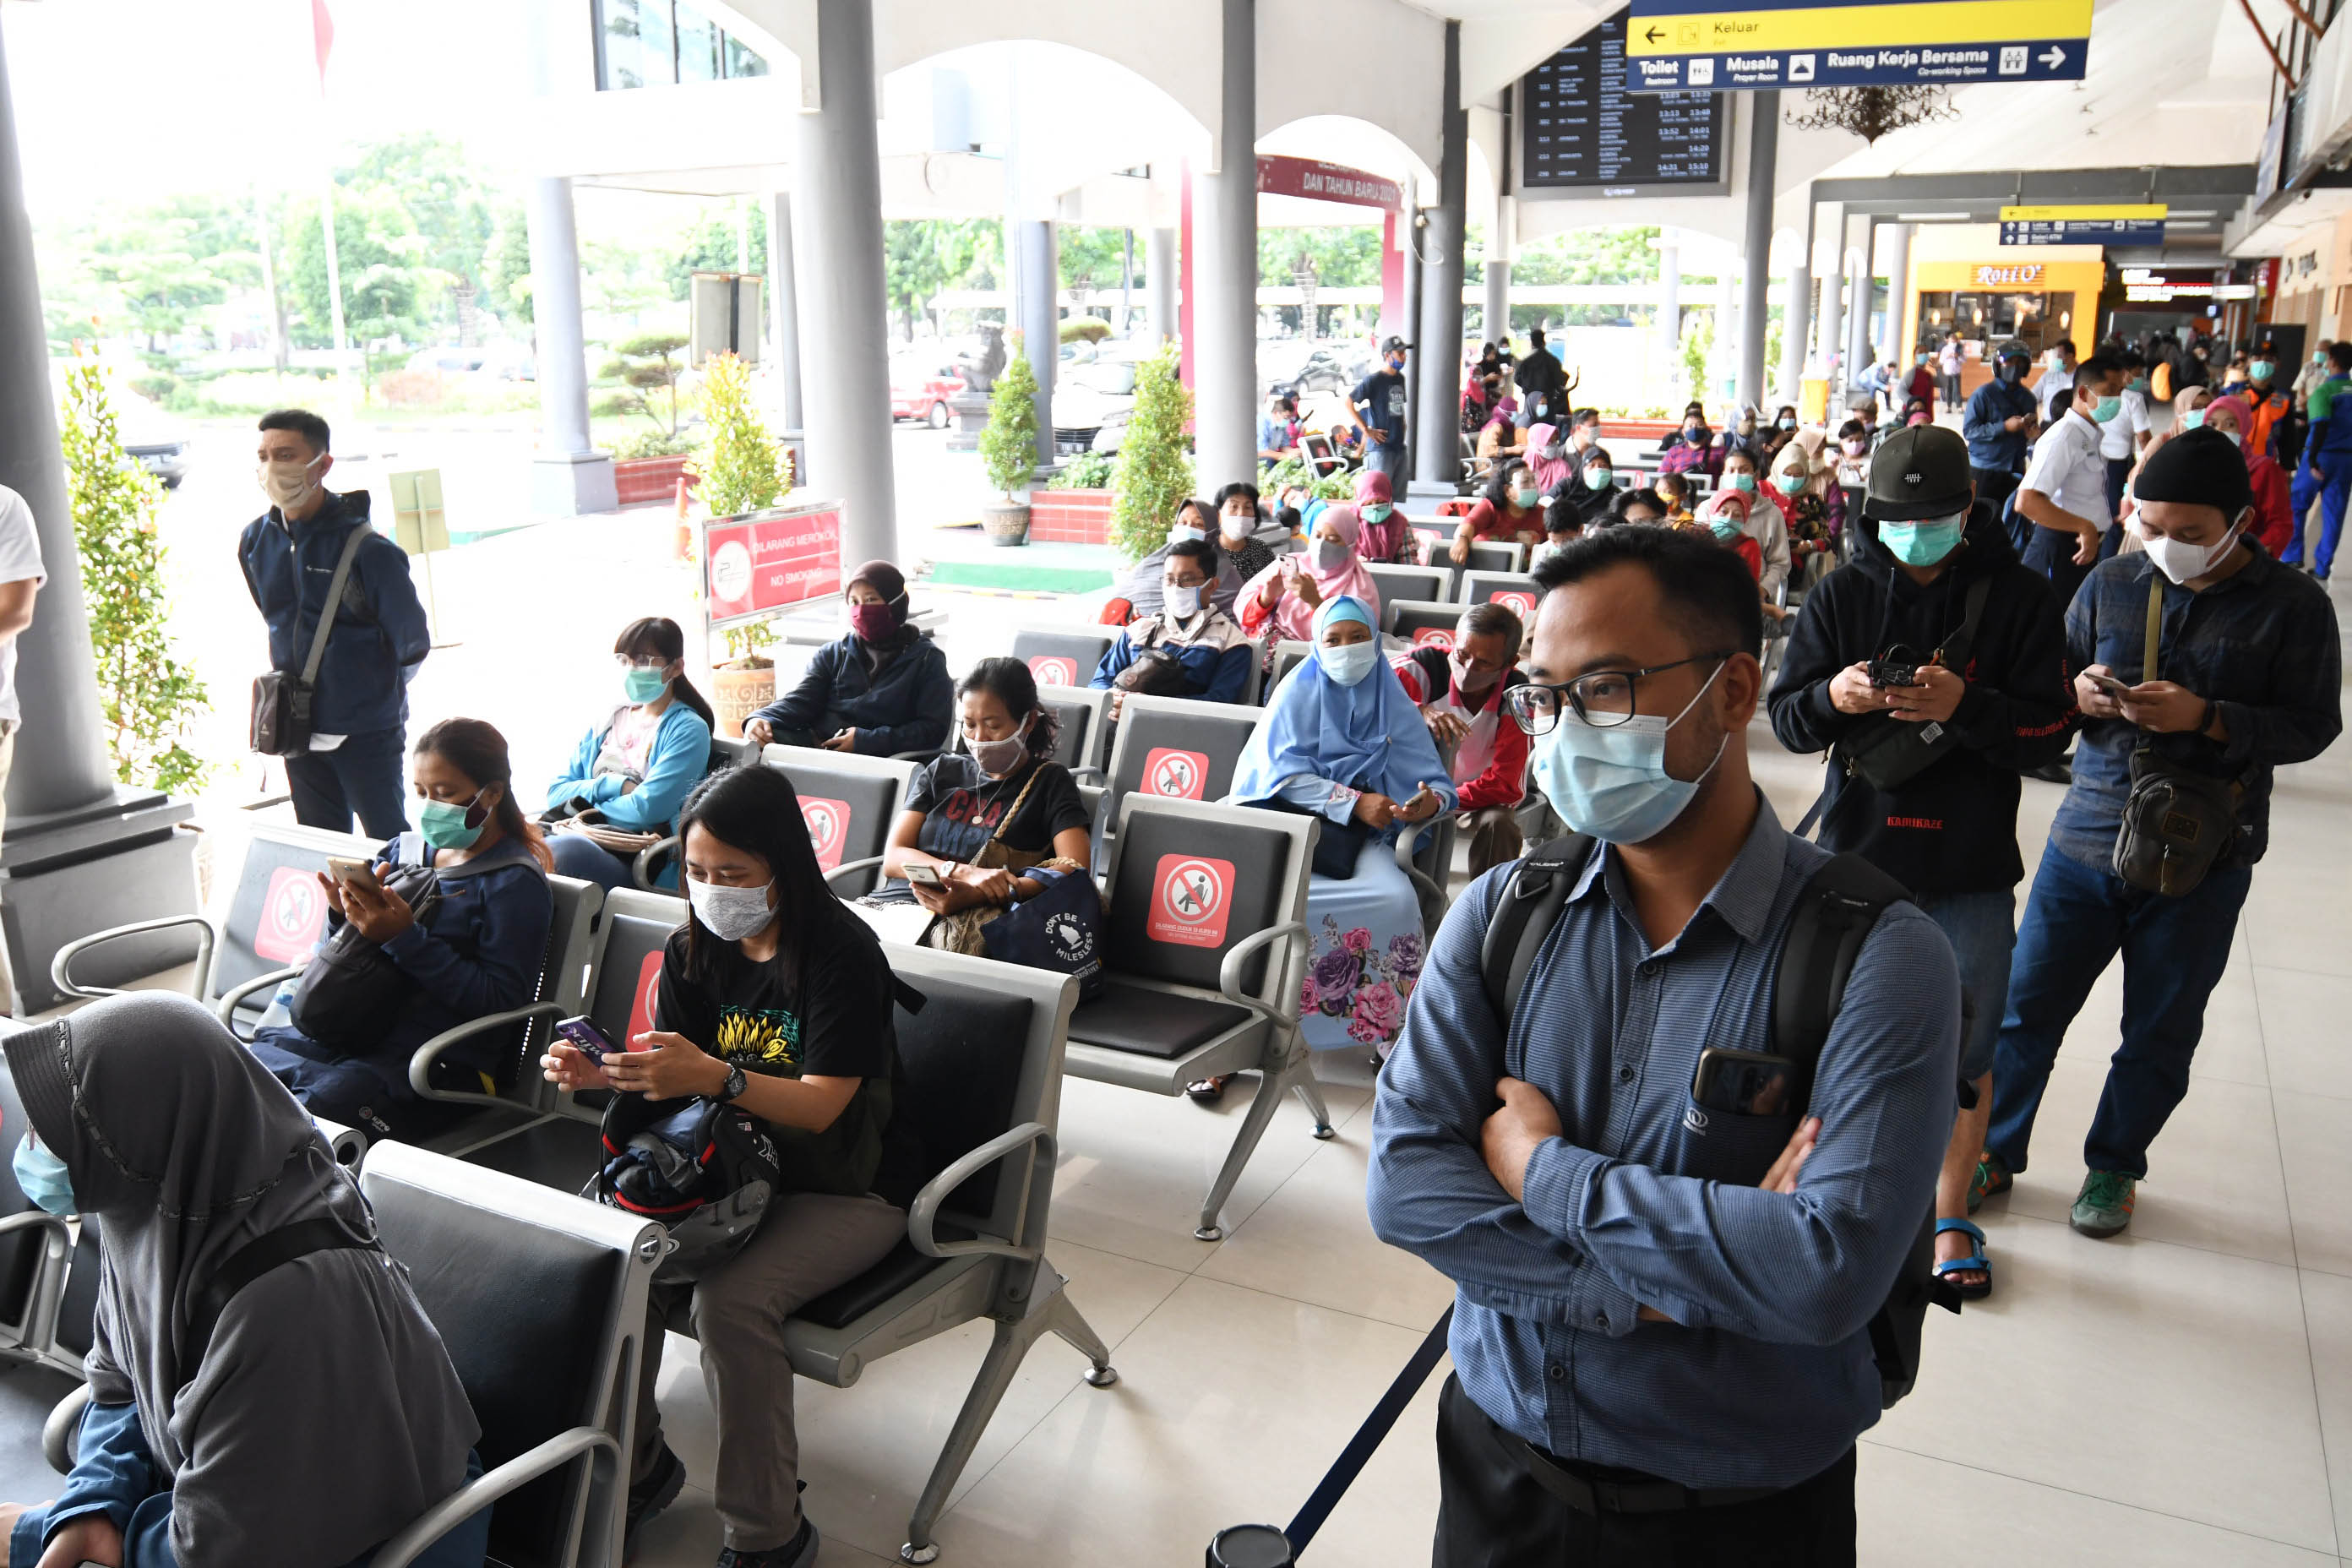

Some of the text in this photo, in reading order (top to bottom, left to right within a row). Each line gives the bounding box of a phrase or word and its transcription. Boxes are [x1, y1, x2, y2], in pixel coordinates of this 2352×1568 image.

[1714, 20, 1759, 33] Keluar
[1639, 60, 1679, 74] Toilet
[1726, 56, 1778, 71] Musala
[1827, 49, 1989, 69] Ruang Kerja Bersama
[1304, 172, 1323, 192] DAN
[1324, 175, 1353, 195] TAHUN
[1354, 180, 1379, 200] BARU
[1978, 266, 2019, 286] Roti
[753, 536, 794, 553] DILARANG
[770, 574, 784, 586] NO
[1045, 912, 1078, 934] DON'T BE
[1056, 932, 1093, 961] MILESLESS
